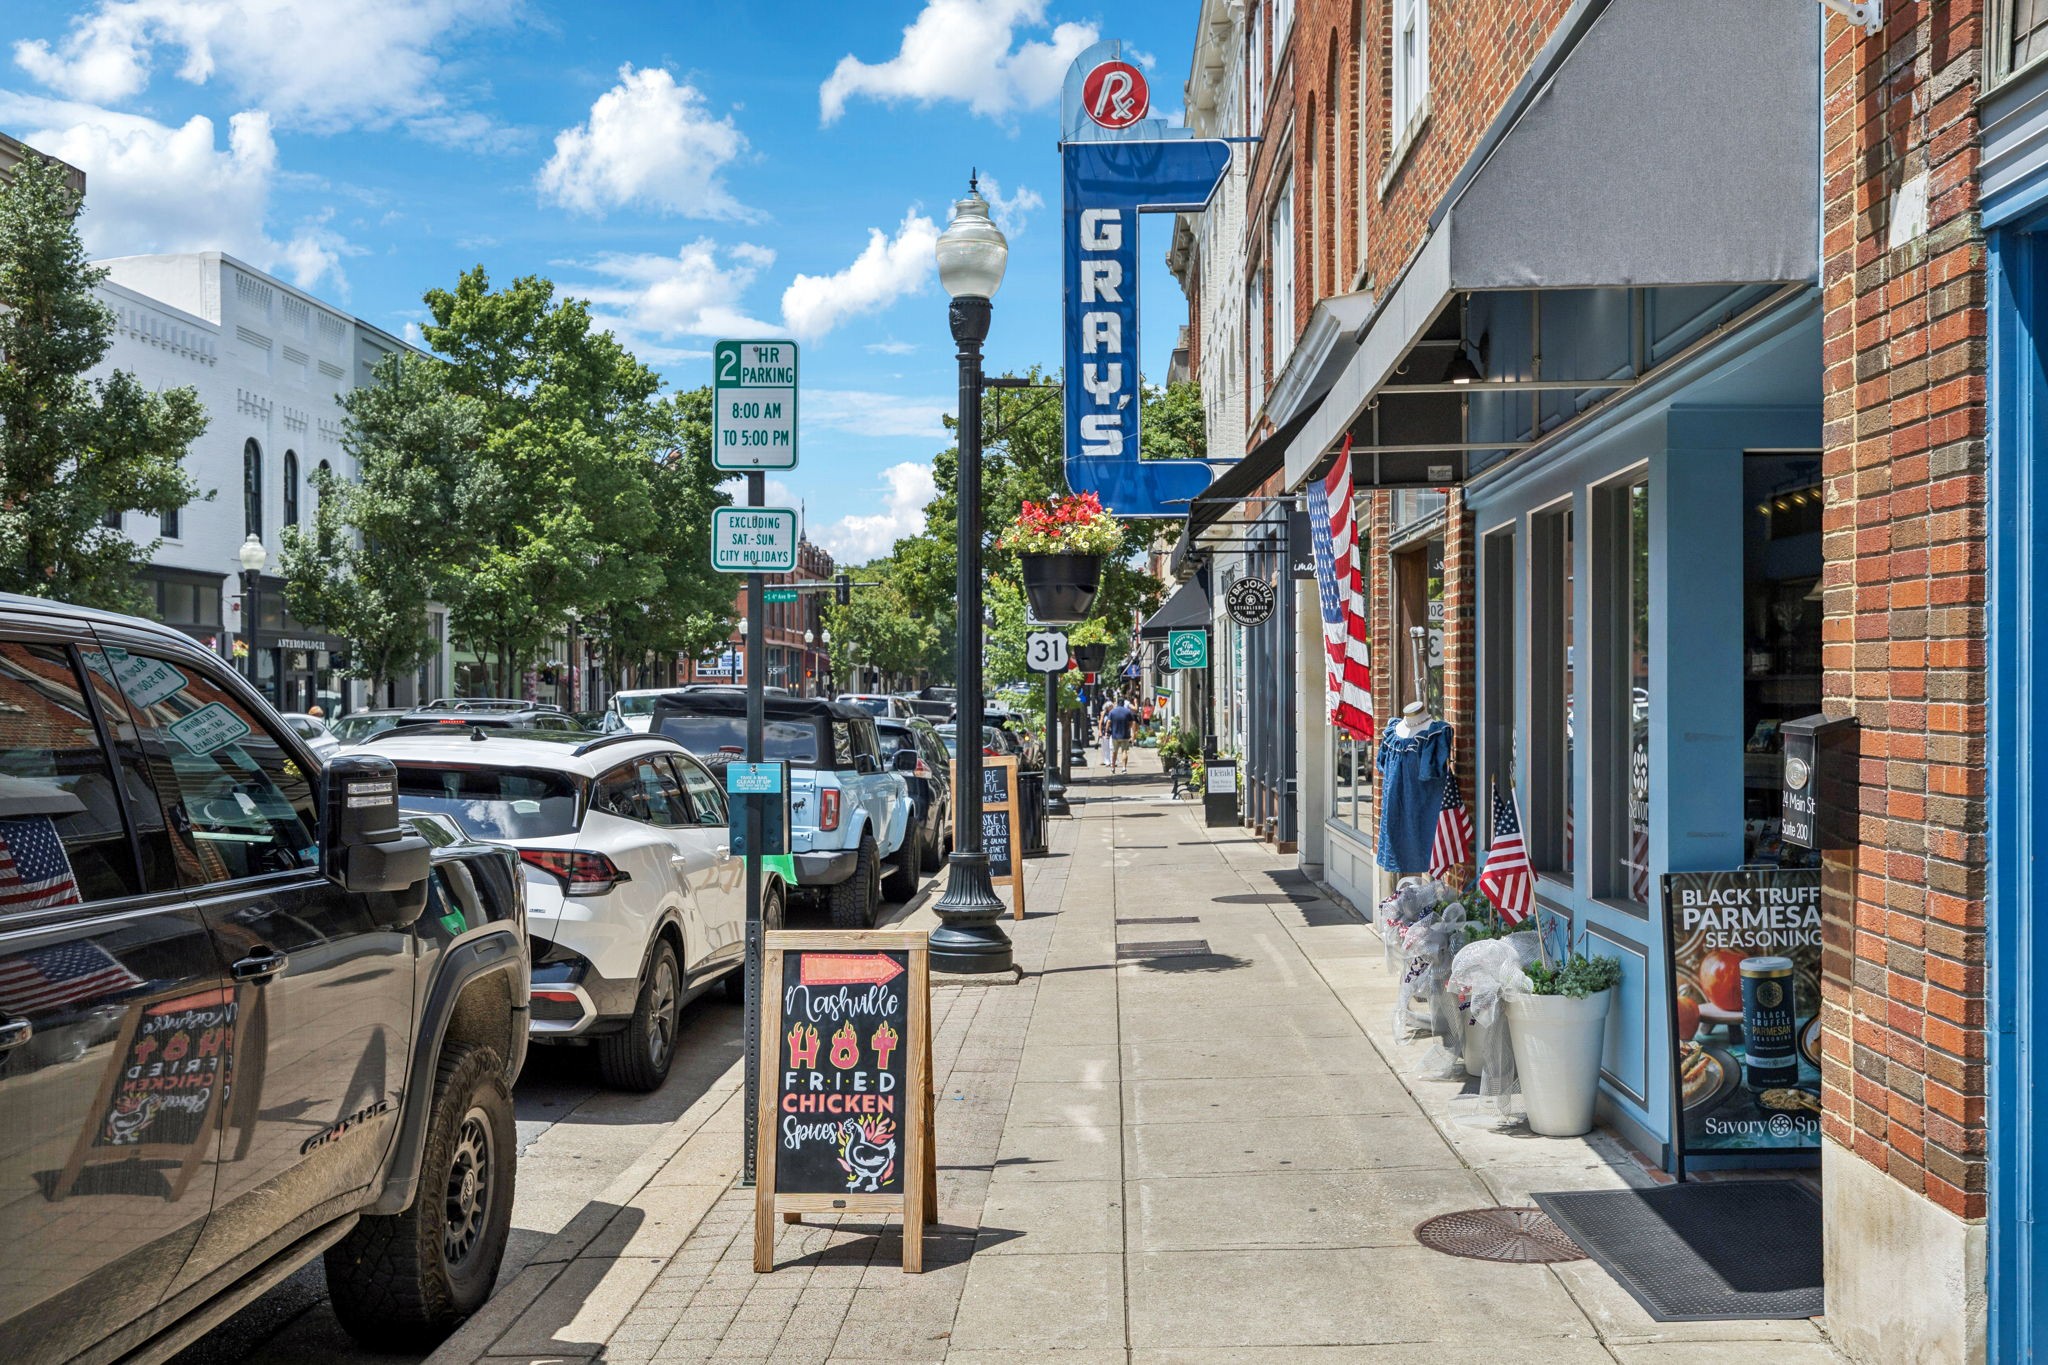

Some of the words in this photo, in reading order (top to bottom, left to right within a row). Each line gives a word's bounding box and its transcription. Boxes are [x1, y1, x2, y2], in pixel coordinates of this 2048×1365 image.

[1080, 208, 1132, 457] GRAY'S
[719, 349, 737, 381] 2
[758, 347, 780, 364] HR
[742, 367, 794, 384] PARKING
[732, 402, 760, 419] 8:00
[764, 402, 782, 419] AM
[723, 430, 737, 446] TO
[741, 430, 769, 446] 5:00
[773, 430, 789, 446] PM
[729, 516, 781, 529] EXCLUDING
[720, 550, 740, 562] CITY
[743, 550, 789, 563] HOLIDAYS
[1244, 580, 1273, 604] JOYFUL
[277, 638, 326, 650] ANTHROPOLOGIE
[1034, 639, 1059, 663] 31
[1175, 647, 1201, 658] Cottage
[1182, 640, 1194, 650] Tin
[984, 770, 999, 785] BE
[1789, 791, 1806, 813] Main
[1806, 796, 1816, 815] St
[1781, 818, 1796, 838] Suite
[1796, 821, 1809, 841] 200
[1681, 887, 1752, 906] BLACK
[1755, 886, 1820, 905] TRUFF
[1683, 905, 1822, 931] PARMESA
[785, 984, 899, 1022] Nashville
[1751, 1017, 1791, 1027] TRUFFLE
[1756, 1010, 1786, 1019] BLACK
[1752, 1025, 1791, 1036] PARMESAN
[787, 1019, 899, 1070] HOT
[782, 1093, 895, 1114] CHICKEN
[783, 1114, 839, 1150] Spices
[1705, 1116, 1768, 1138] Savory
